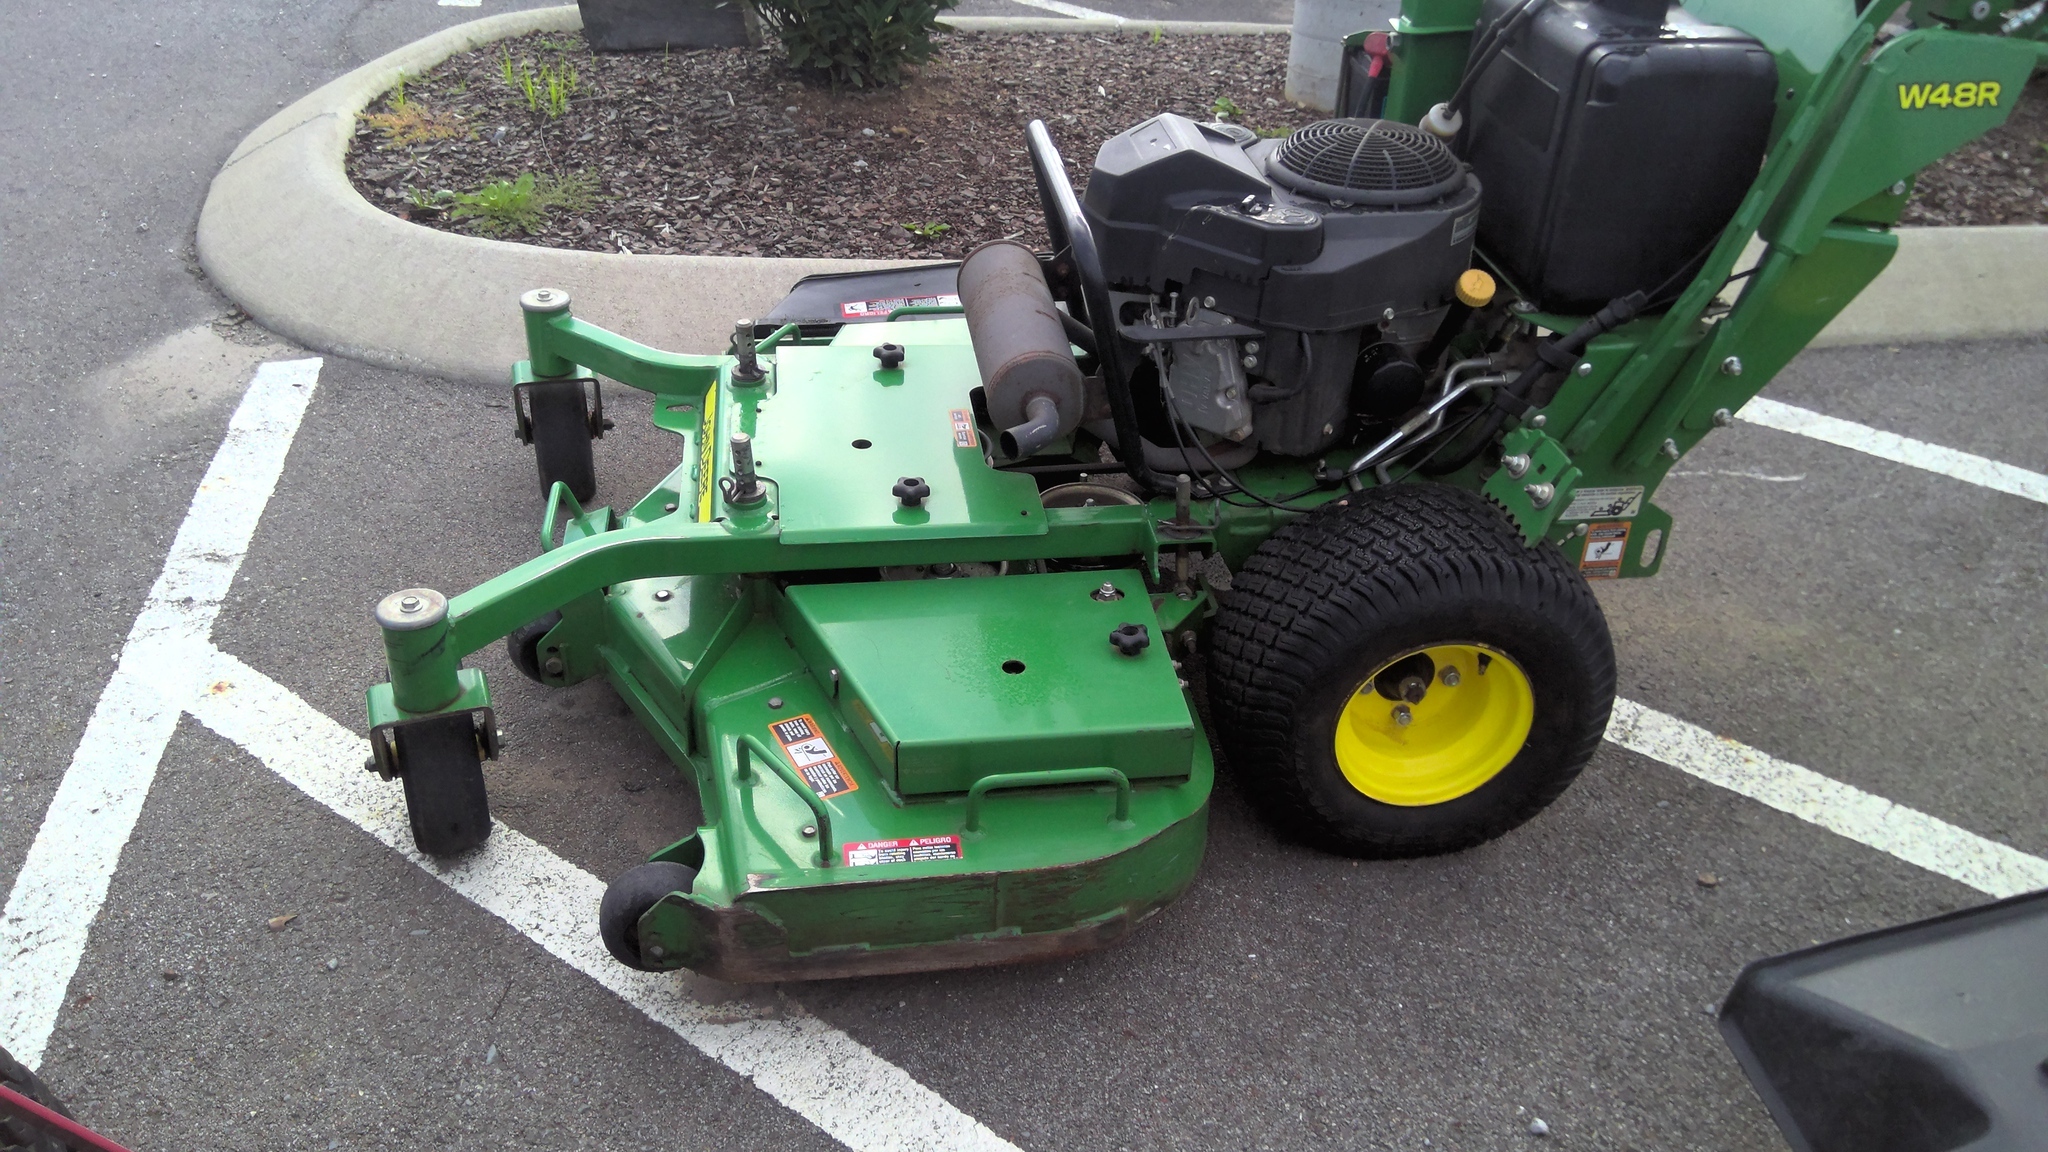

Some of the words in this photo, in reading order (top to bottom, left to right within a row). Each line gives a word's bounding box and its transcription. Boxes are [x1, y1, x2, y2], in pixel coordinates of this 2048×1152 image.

[1898, 81, 2001, 110] W48R
[867, 840, 899, 849] DANGER
[919, 836, 952, 845] PELIGRO
